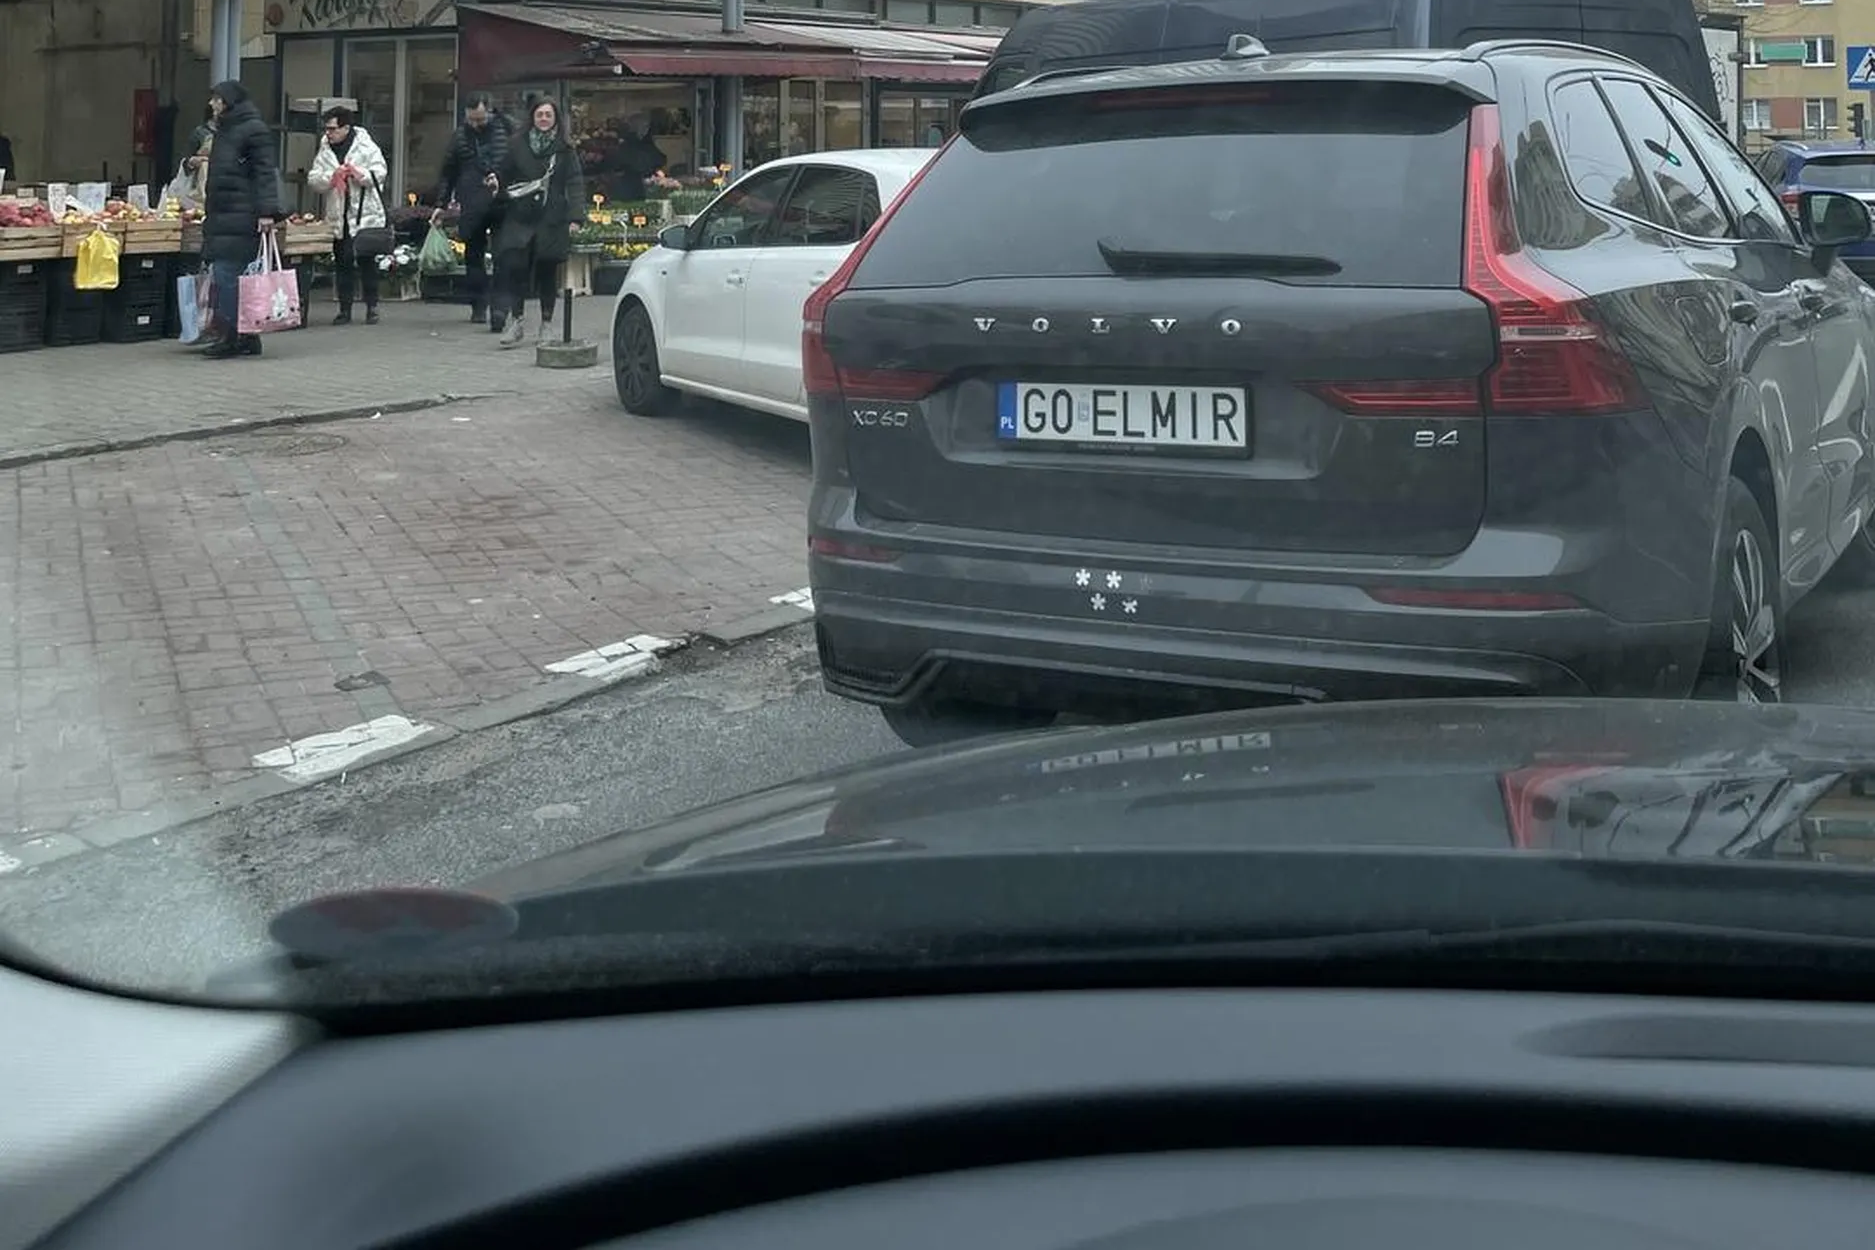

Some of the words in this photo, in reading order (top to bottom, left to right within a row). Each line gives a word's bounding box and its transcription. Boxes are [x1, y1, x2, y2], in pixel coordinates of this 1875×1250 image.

[973, 316, 1242, 336] VOLVO
[1000, 416, 1015, 430] PL
[1415, 429, 1460, 448] B4
